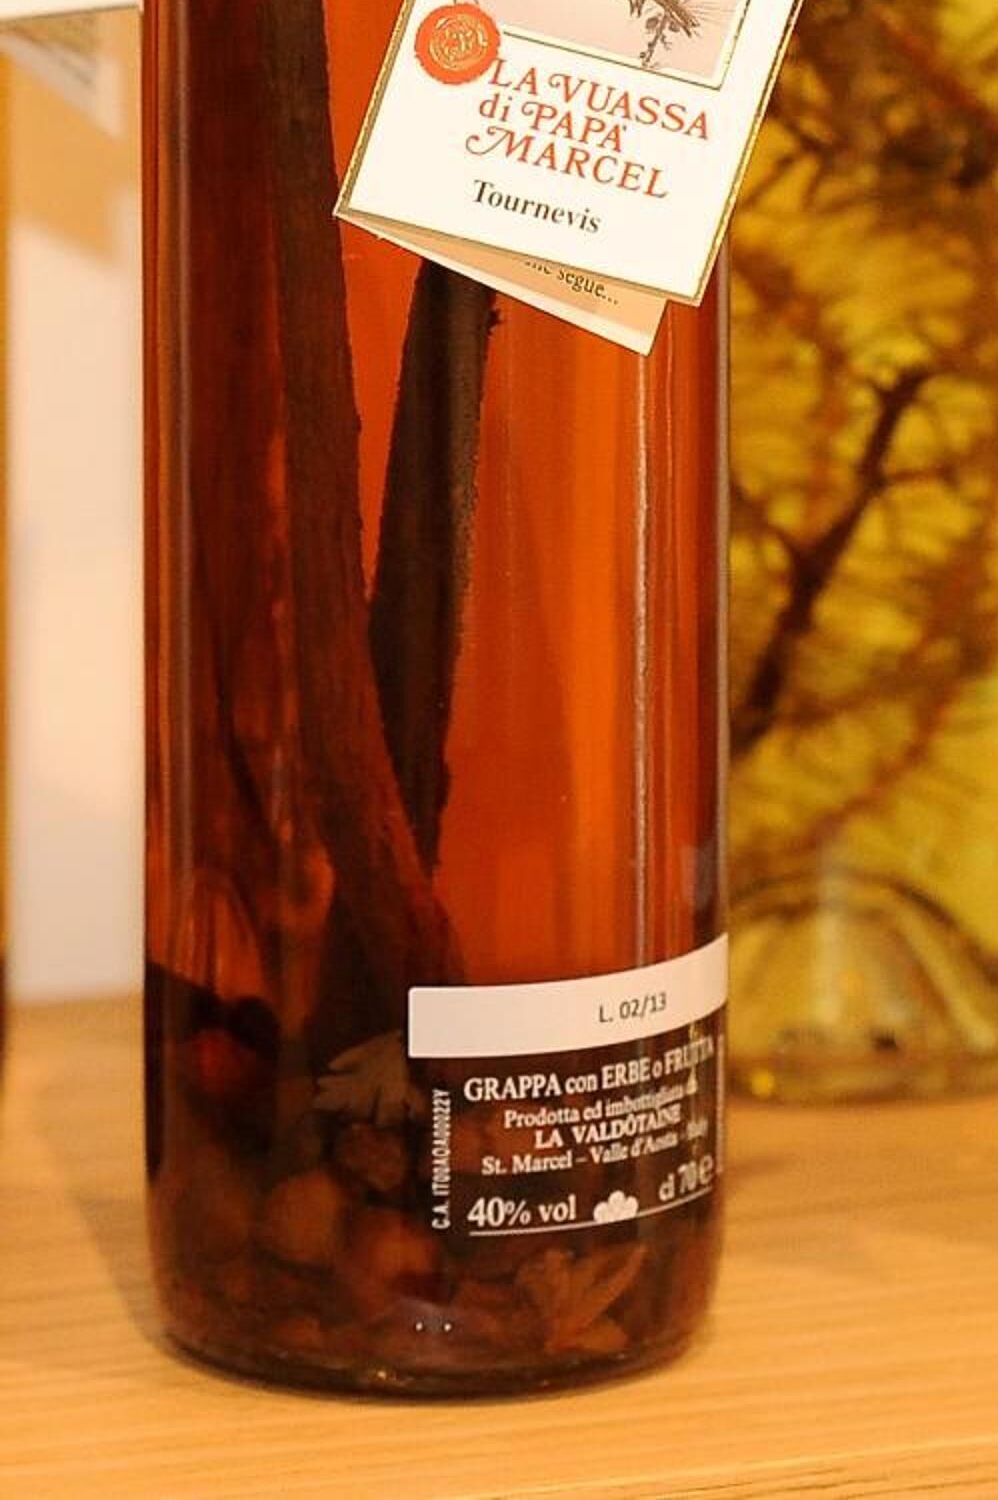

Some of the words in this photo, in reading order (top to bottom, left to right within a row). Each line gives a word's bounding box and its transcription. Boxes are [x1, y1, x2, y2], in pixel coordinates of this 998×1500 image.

[478, 93, 513, 122] di
[487, 58, 539, 96] LA
[547, 72, 711, 141] VUASSA
[465, 125, 669, 199] MARCEL
[472, 179, 602, 235] Tournevis
[599, 1004, 614, 1023] L.
[619, 992, 667, 1020] 02/13
[463, 1072, 563, 1103] GRAPPA
[564, 1073, 600, 1095] con
[601, 1056, 651, 1090] ERBE
[651, 1058, 663, 1079] o
[503, 1106, 581, 1129] Prodotta
[583, 1099, 603, 1121] ed
[534, 1126, 565, 1150] LA
[481, 1154, 508, 1176] St.
[511, 1148, 574, 1176] Marcel
[588, 1140, 629, 1164] Valle
[466, 1195, 532, 1228] 40%
[538, 1192, 577, 1223] vol
